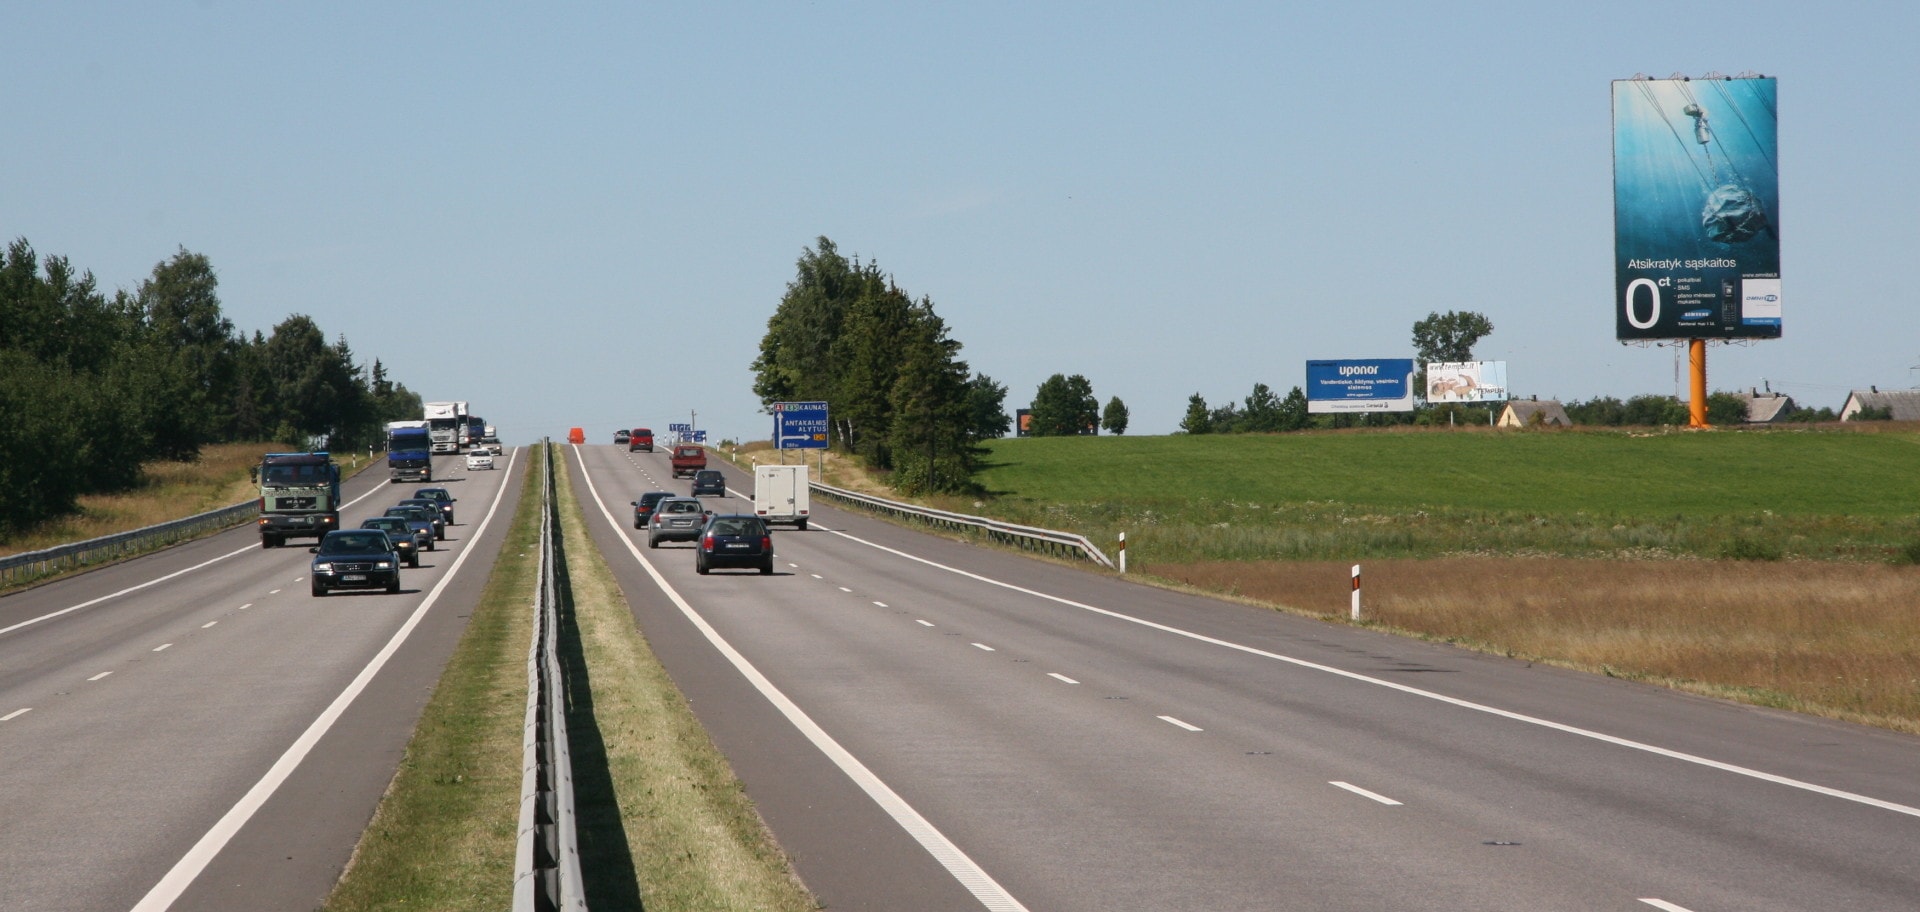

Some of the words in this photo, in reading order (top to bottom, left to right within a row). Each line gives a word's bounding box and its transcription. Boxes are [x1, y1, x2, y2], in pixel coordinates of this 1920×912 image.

[1628, 258, 1682, 271] Atsikratyk
[1685, 258, 1736, 271] sąskaitos
[1658, 276, 1671, 287] ct
[1626, 278, 1660, 329] 0
[1339, 366, 1379, 377] uponor
